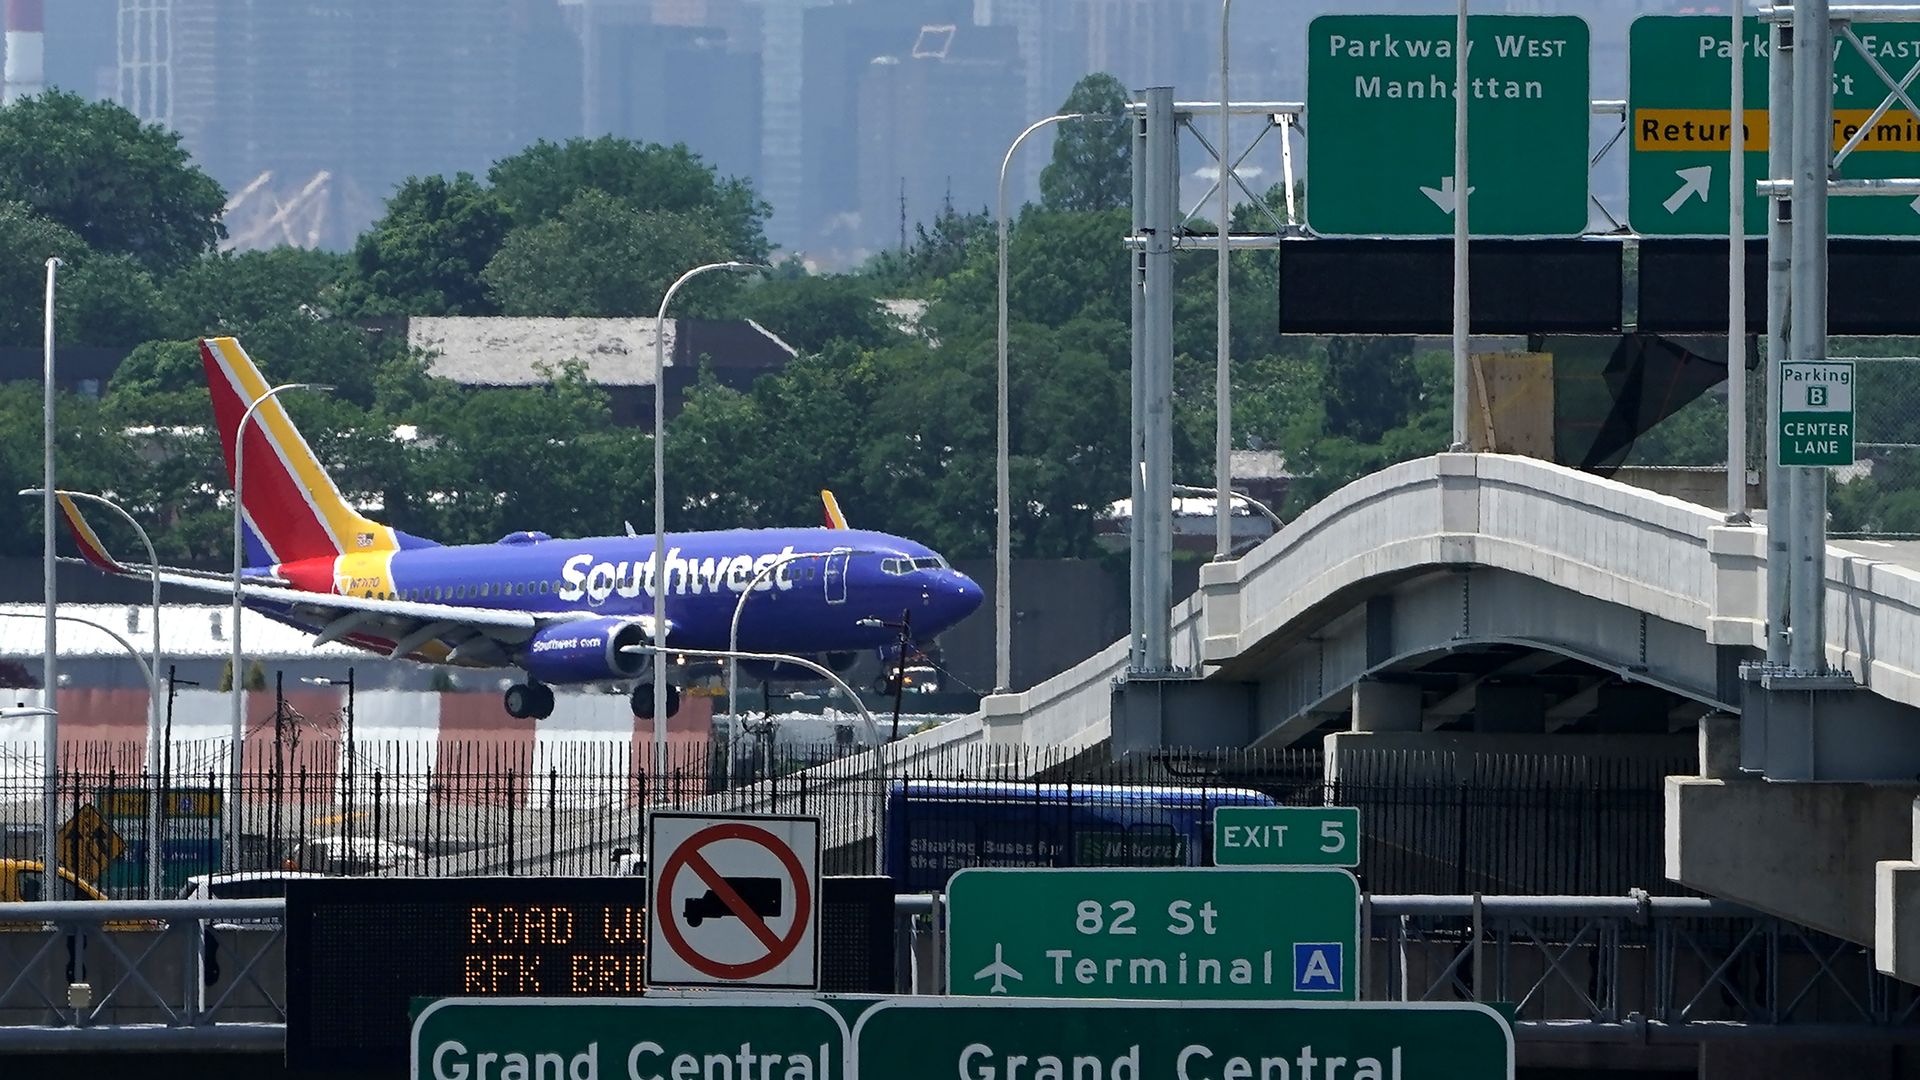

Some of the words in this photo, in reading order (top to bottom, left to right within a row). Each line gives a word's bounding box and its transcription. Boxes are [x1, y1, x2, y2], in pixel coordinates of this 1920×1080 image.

[1495, 35, 1567, 57] WEST
[1784, 368, 1849, 385] Parking
[1810, 387, 1824, 405] B
[1784, 423, 1849, 436] CENTER
[1795, 441, 1838, 454] LANE
[558, 546, 795, 601] Southwest
[1224, 826, 1288, 847] EXIT
[1320, 821, 1346, 853] 5
[471, 907, 573, 944] ROAD
[1075, 900, 1137, 934] 82
[1167, 900, 1218, 935] St
[465, 954, 540, 992] RFK
[1046, 950, 1272, 984] Terminal
[1302, 950, 1335, 984] A
[433, 1041, 599, 1080] Grand
[627, 1042, 829, 1080] Central
[959, 1043, 1140, 1080] Grand
[1177, 1044, 1401, 1080] Central
